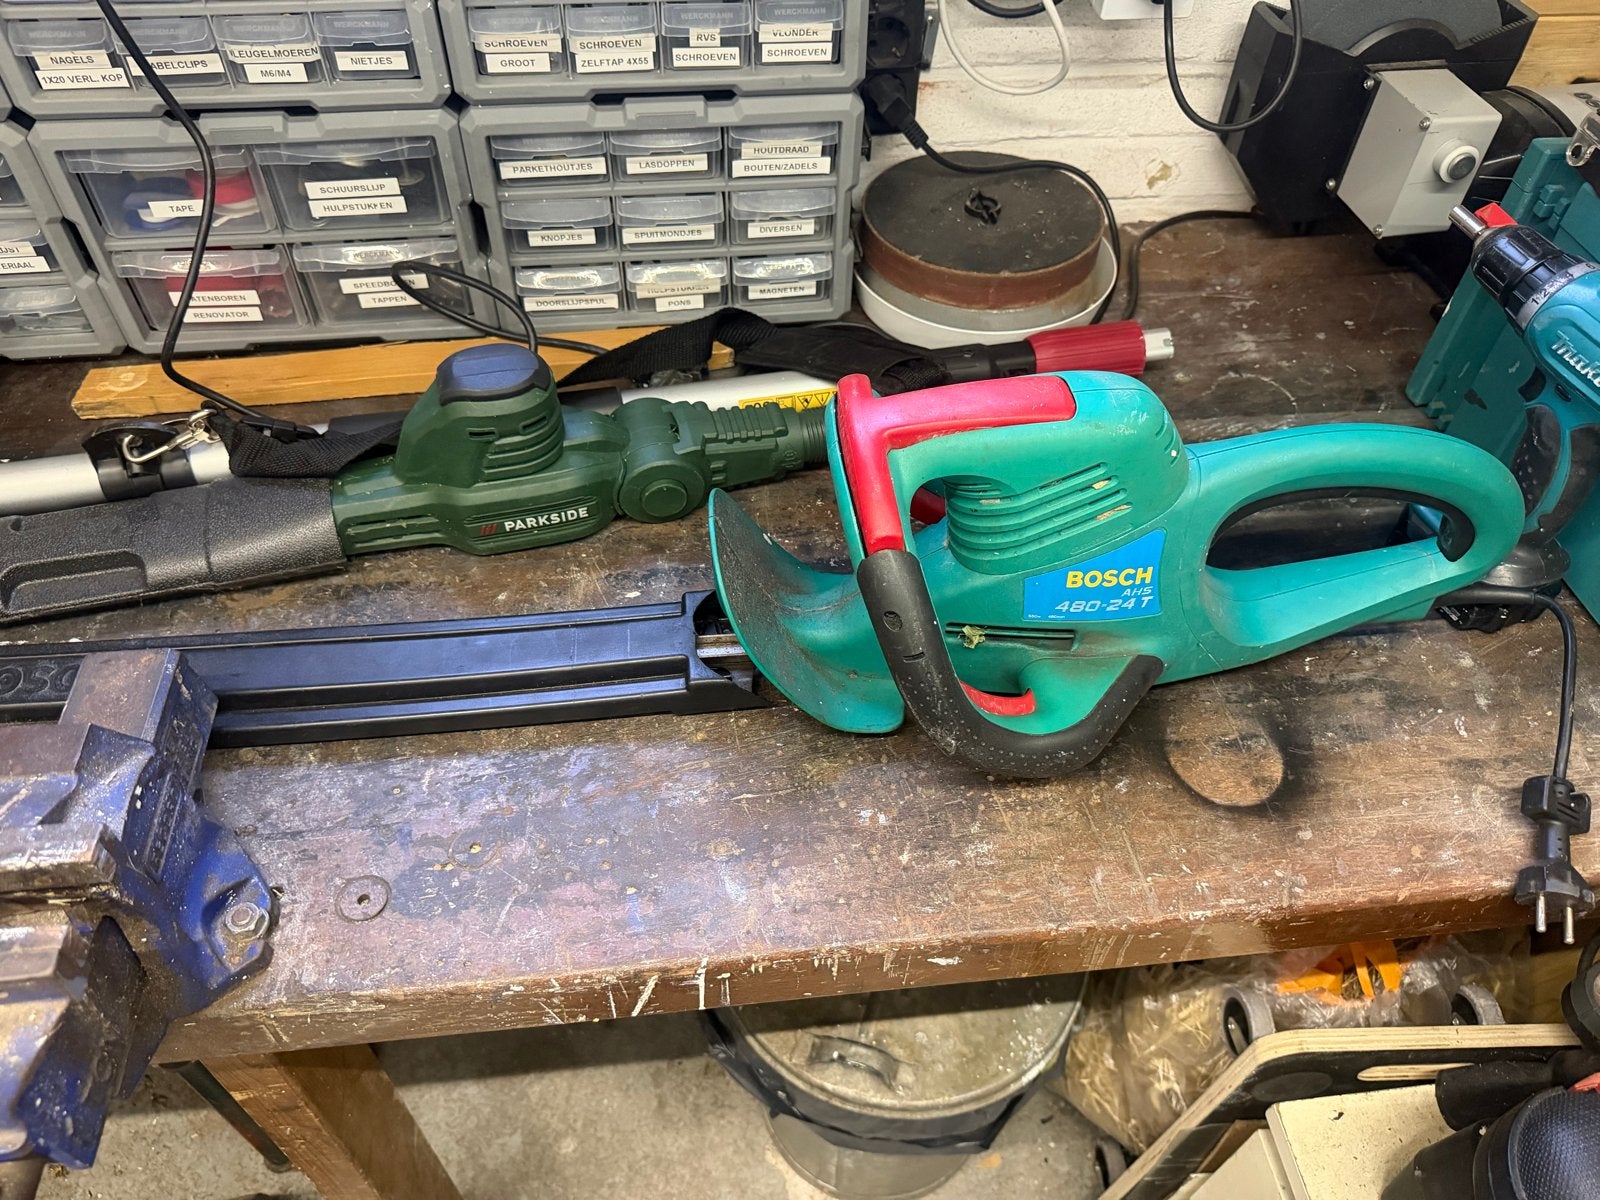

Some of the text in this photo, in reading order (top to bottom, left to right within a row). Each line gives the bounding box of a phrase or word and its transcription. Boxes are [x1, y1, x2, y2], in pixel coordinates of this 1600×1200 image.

[696, 34, 717, 42] RVS
[485, 39, 548, 48] SCHROEVEN
[579, 39, 642, 49] SCHROEVEN
[675, 53, 737, 62] SCHROEVEN
[767, 48, 828, 57] SCHROEVEN
[50, 55, 95, 64] NAGELS
[150, 59, 209, 69] ABELCLIPS
[350, 56, 393, 66] NIETJES
[500, 59, 536, 67] GROOT
[581, 57, 649, 68] ZELFTAP 4X55
[42, 73, 123, 84] 1X20 VERL. KOP
[260, 69, 292, 78] M6/M4
[753, 146, 810, 155] HOUTDRAAD
[512, 162, 593, 174] PARKETHOUTJES
[639, 159, 695, 169] LASDOPPEN
[744, 162, 818, 172] BOUTEN/ZADELS
[320, 183, 386, 194] SCHUURSLIJP
[168, 204, 195, 213] TAPE
[759, 223, 803, 233] DIVERSEN
[541, 232, 583, 242] KNOPJES
[634, 229, 702, 239] SPUITMONDJES
[353, 279, 416, 289] SPEEDBON
[759, 286, 805, 295] MAGNETEN
[191, 294, 247, 302] ATENBOREN
[372, 295, 408, 304] TAPPEN
[535, 297, 608, 307] DOORSLIJPSPUL
[668, 299, 692, 307] PONS
[193, 311, 250, 319] RENOVATOR
[504, 507, 589, 532] PARKSIDE
[1065, 566, 1154, 589] BOSCH
[1121, 586, 1153, 597] AHS
[1055, 595, 1154, 613] 480-24 T
